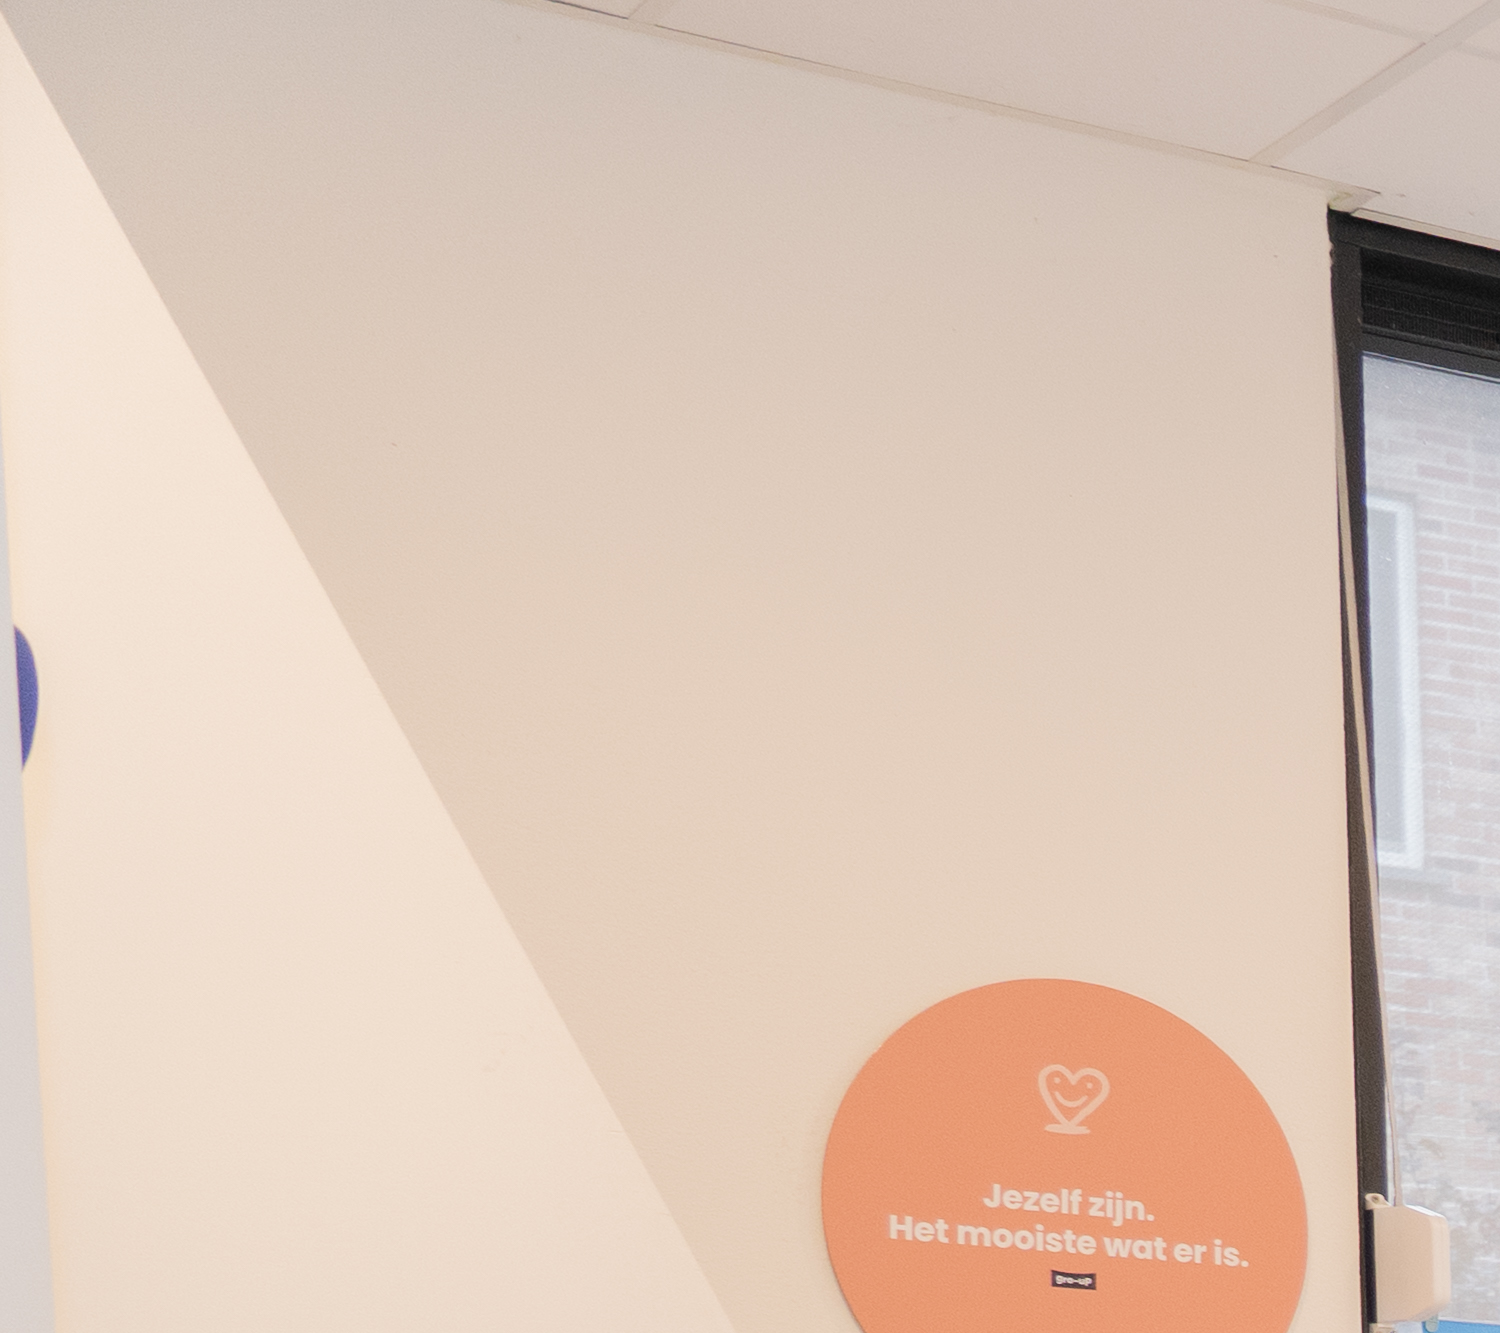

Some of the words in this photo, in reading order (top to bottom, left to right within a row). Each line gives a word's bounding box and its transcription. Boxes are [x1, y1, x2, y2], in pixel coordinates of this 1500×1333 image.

[983, 1184, 1083, 1216] Jezelf
[1088, 1191, 1156, 1227] zijn.
[888, 1214, 949, 1246] Het
[957, 1223, 1098, 1257] mooiste
[1103, 1237, 1167, 1262] wat
[1173, 1243, 1208, 1265] er
[1213, 1239, 1250, 1269] is.
